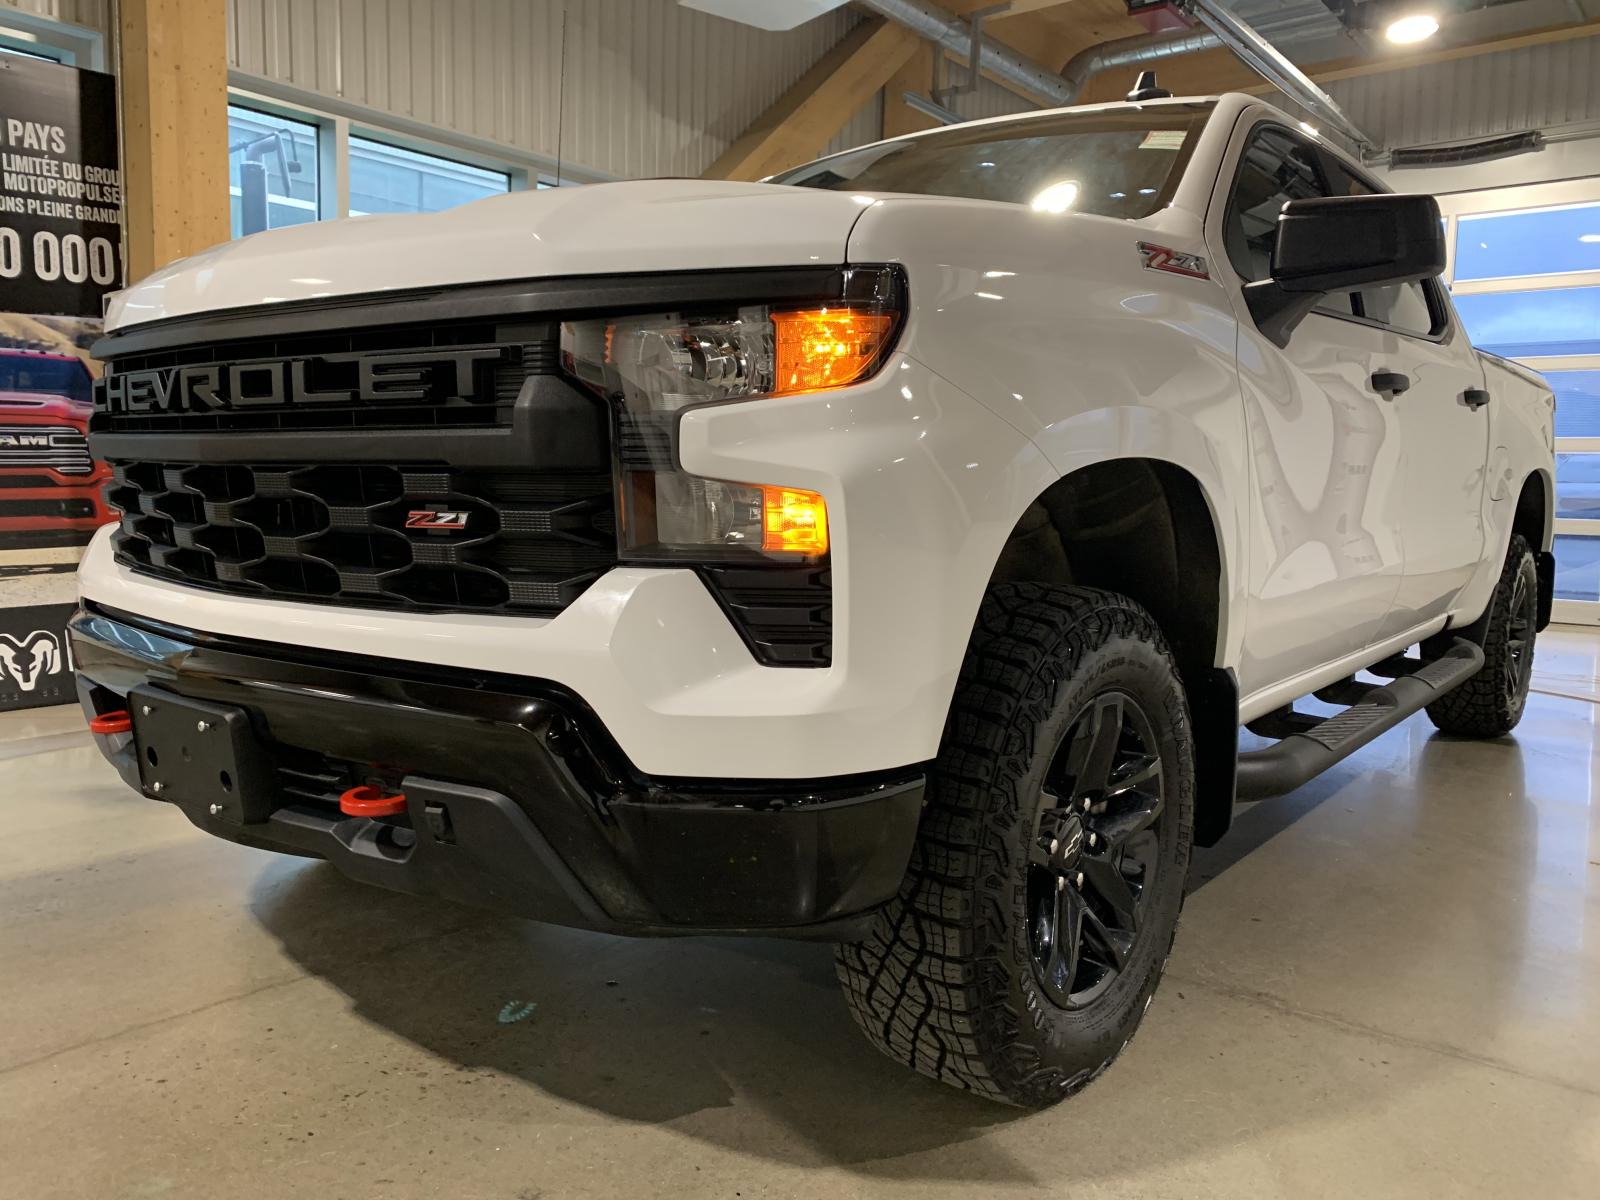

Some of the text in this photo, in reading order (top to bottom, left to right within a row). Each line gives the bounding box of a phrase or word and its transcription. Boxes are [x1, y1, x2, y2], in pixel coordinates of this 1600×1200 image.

[8, 118, 66, 153] PAYS
[2, 152, 60, 178] LIMITÉE
[62, 162, 82, 180] DU
[3, 172, 120, 204] MOTOPROPULSE
[26, 199, 74, 220] PLEINE
[33, 231, 115, 285] 000
[92, 349, 501, 413] CHEVROLET
[405, 510, 470, 530] Z71
